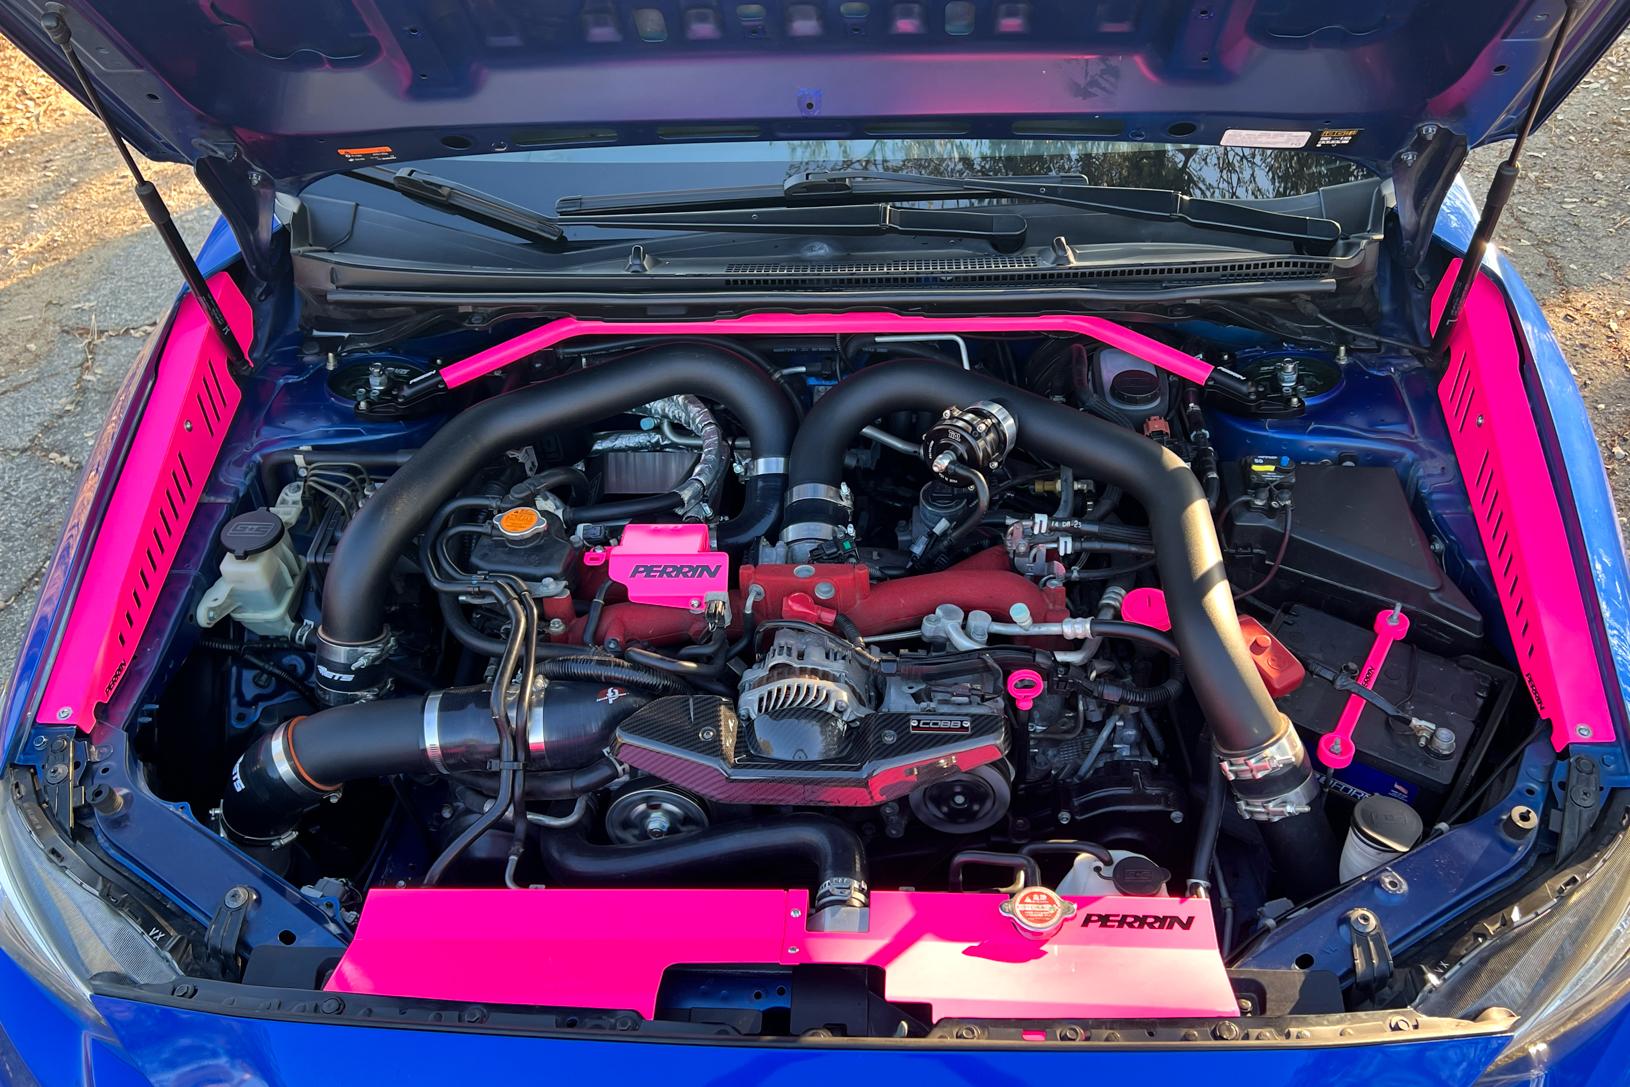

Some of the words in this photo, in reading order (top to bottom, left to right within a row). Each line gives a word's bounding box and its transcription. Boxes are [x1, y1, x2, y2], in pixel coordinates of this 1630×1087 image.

[628, 564, 722, 578] PERRIN
[104, 658, 127, 697] PERRIN
[1525, 671, 1545, 711] PERRIN
[919, 720, 962, 728] COBB
[1080, 913, 1196, 931] PERRIN
